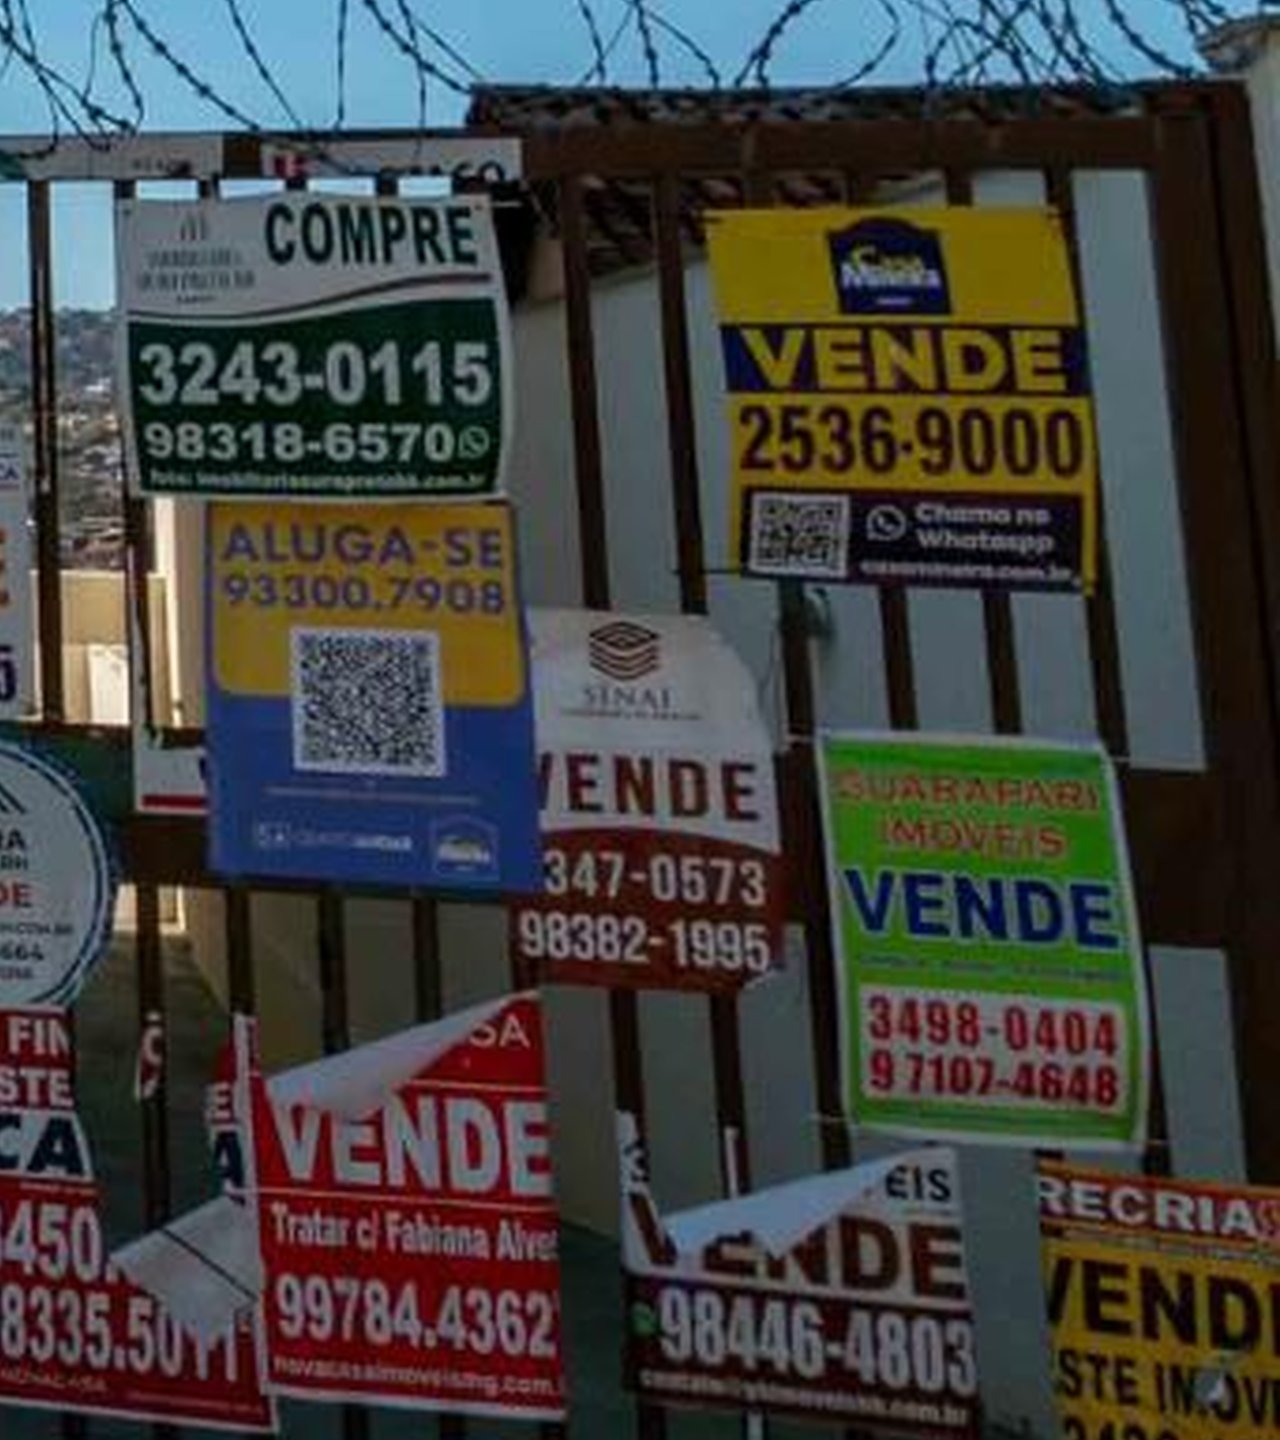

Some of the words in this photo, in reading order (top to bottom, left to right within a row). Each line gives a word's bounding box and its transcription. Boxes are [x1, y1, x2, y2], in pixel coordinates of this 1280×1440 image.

[264, 202, 478, 265] COMPRE
[139, 340, 493, 406] 3243-0115
[740, 328, 1068, 392] VENDE
[144, 421, 456, 462] 98318-6570
[914, 501, 1011, 525] Chama
[221, 524, 503, 569] ALUGA-SE
[223, 576, 506, 614] 93300.7908
[841, 867, 1121, 950] VENDE
[519, 910, 770, 971] 98382-1995
[868, 994, 1118, 1057] 3498-0404
[272, 1095, 558, 1197] VENDE
[272, 1200, 350, 1246] Tratar
[387, 1211, 489, 1259] Fabiana
[274, 1274, 558, 1358] 99784.4362
[659, 1287, 978, 1396] 98446-4803
